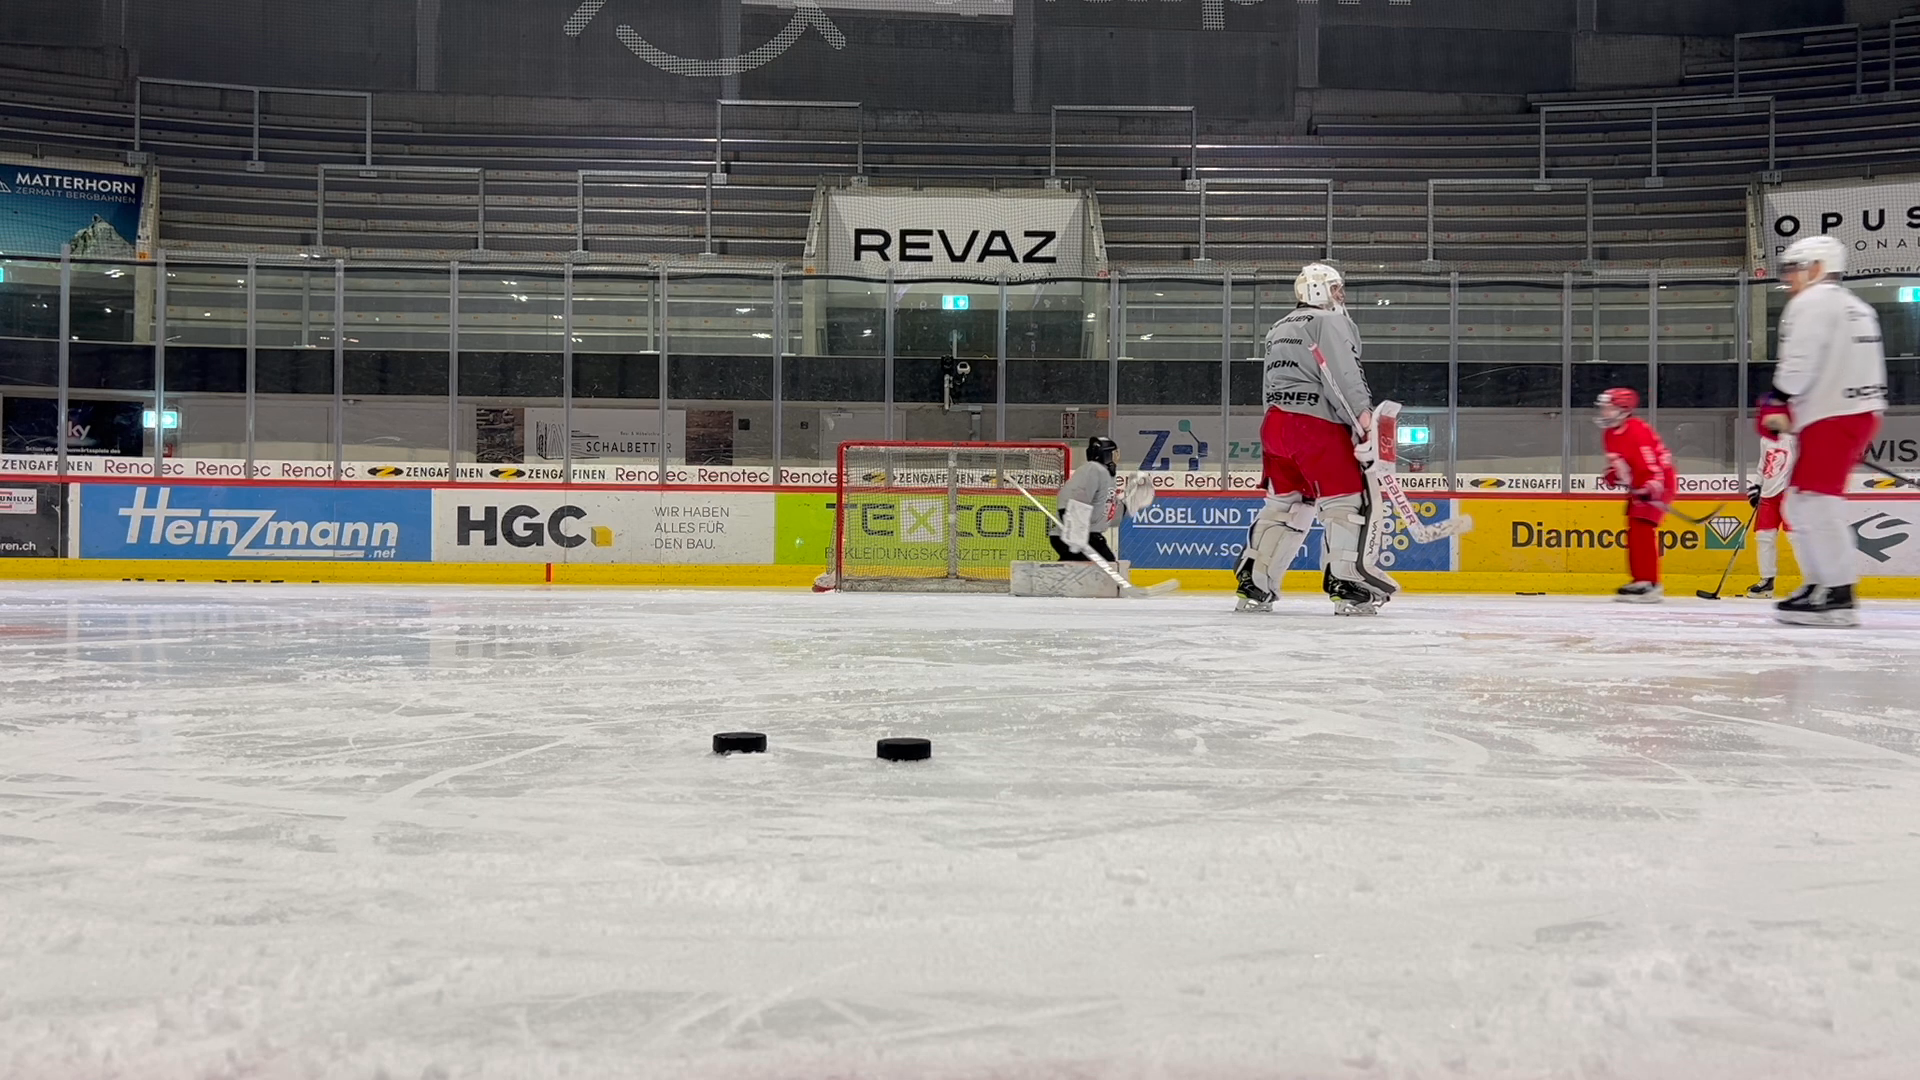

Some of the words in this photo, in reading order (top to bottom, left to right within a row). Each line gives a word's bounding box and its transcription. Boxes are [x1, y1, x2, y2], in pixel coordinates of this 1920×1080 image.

[15, 172, 136, 194] MATTERHORN
[15, 187, 62, 198] ZERMATT
[65, 191, 136, 204] BERGBAHNEN
[1774, 206, 1920, 237] OPUS
[854, 228, 1057, 264] REVAZ
[67, 421, 91, 440] ky
[104, 459, 184, 475] Renoec
[282, 462, 356, 478] Renotc
[406, 467, 483, 478] ZENGAFINEN
[528, 468, 606, 480] ZENGAFINEN
[615, 467, 688, 482] Renoec
[698, 468, 770, 483] Renotec
[780, 469, 846, 484] Renote
[1508, 478, 1585, 489] ZENGAFFIEN
[654, 506, 680, 518] WIR
[683, 506, 730, 518] HABEN
[1133, 504, 1197, 525] MÖBEL
[1202, 507, 1242, 525] UND
[457, 505, 587, 548] HGC
[654, 522, 695, 534] ALLES
[698, 520, 725, 534] FÜR
[0, 541, 37, 551] ren.ch
[654, 538, 682, 550] DEN
[686, 538, 716, 550] BAU.
[1511, 520, 1699, 557] Diamcope
[368, 548, 396, 558] .net
